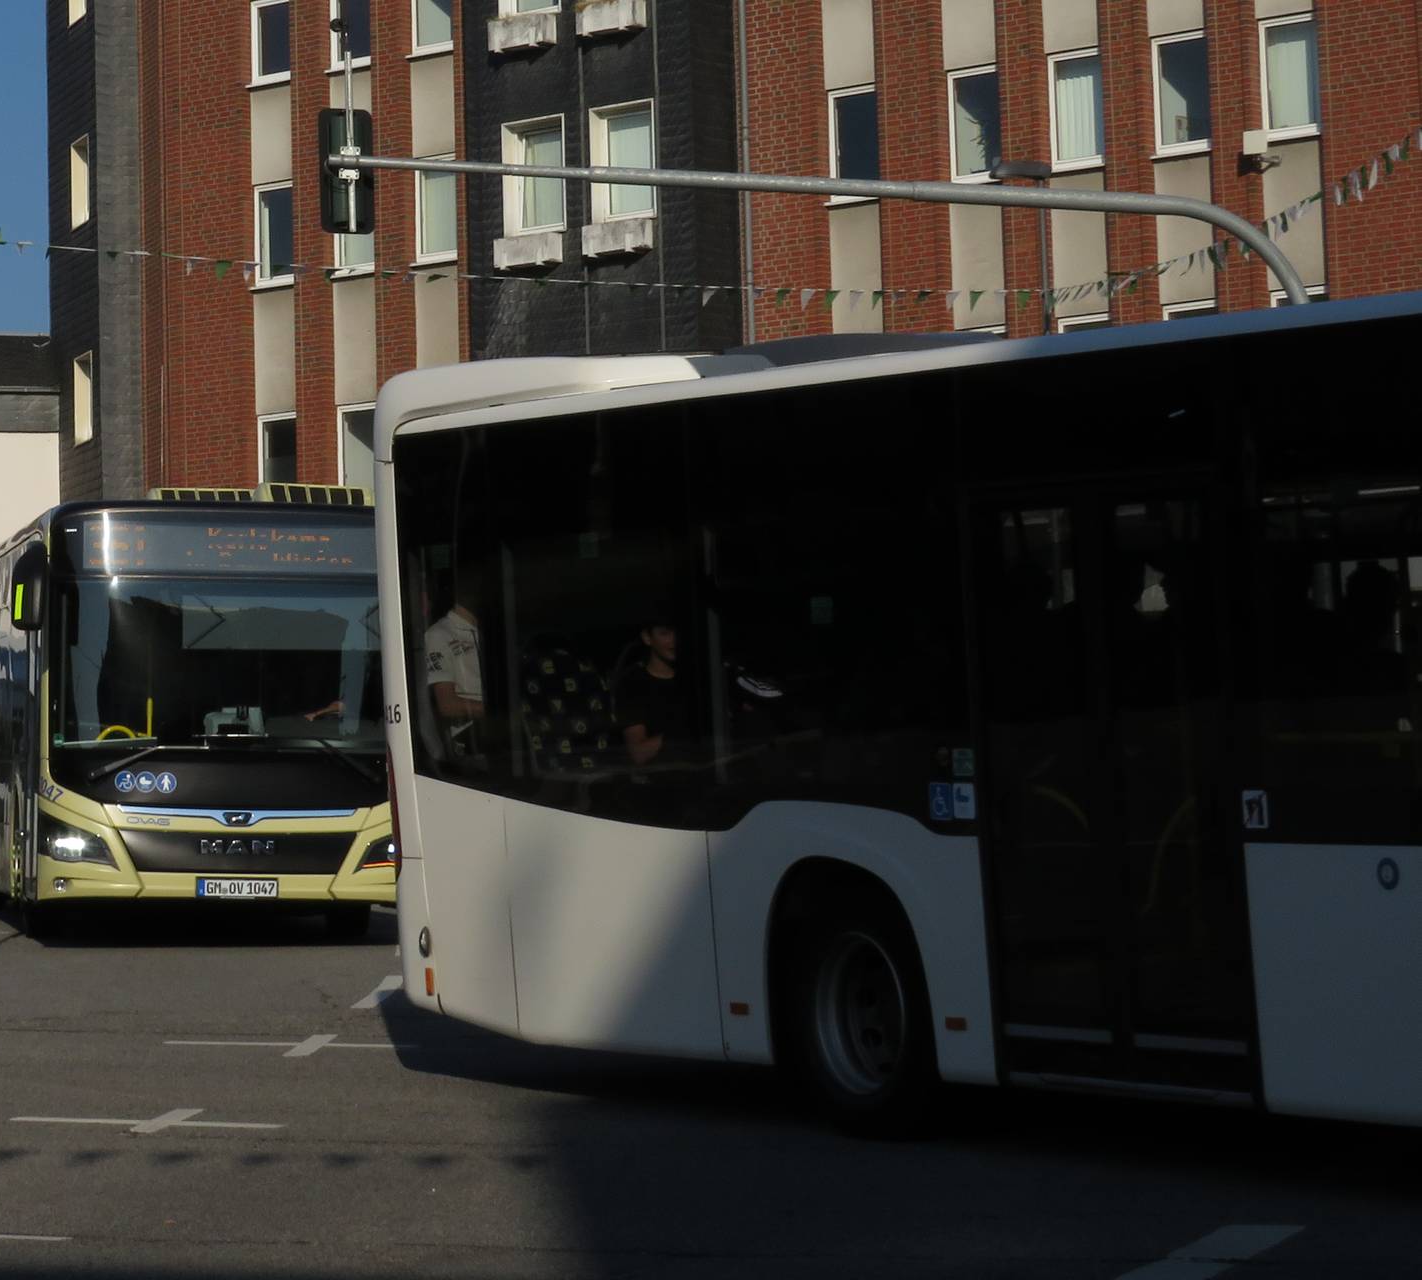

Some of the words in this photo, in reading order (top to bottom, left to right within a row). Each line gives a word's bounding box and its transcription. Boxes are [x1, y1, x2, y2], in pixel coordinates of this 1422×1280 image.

[200, 839, 275, 855] MAN
[206, 882, 222, 895] GM
[229, 882, 244, 895] OV
[246, 882, 275, 895] 1047
